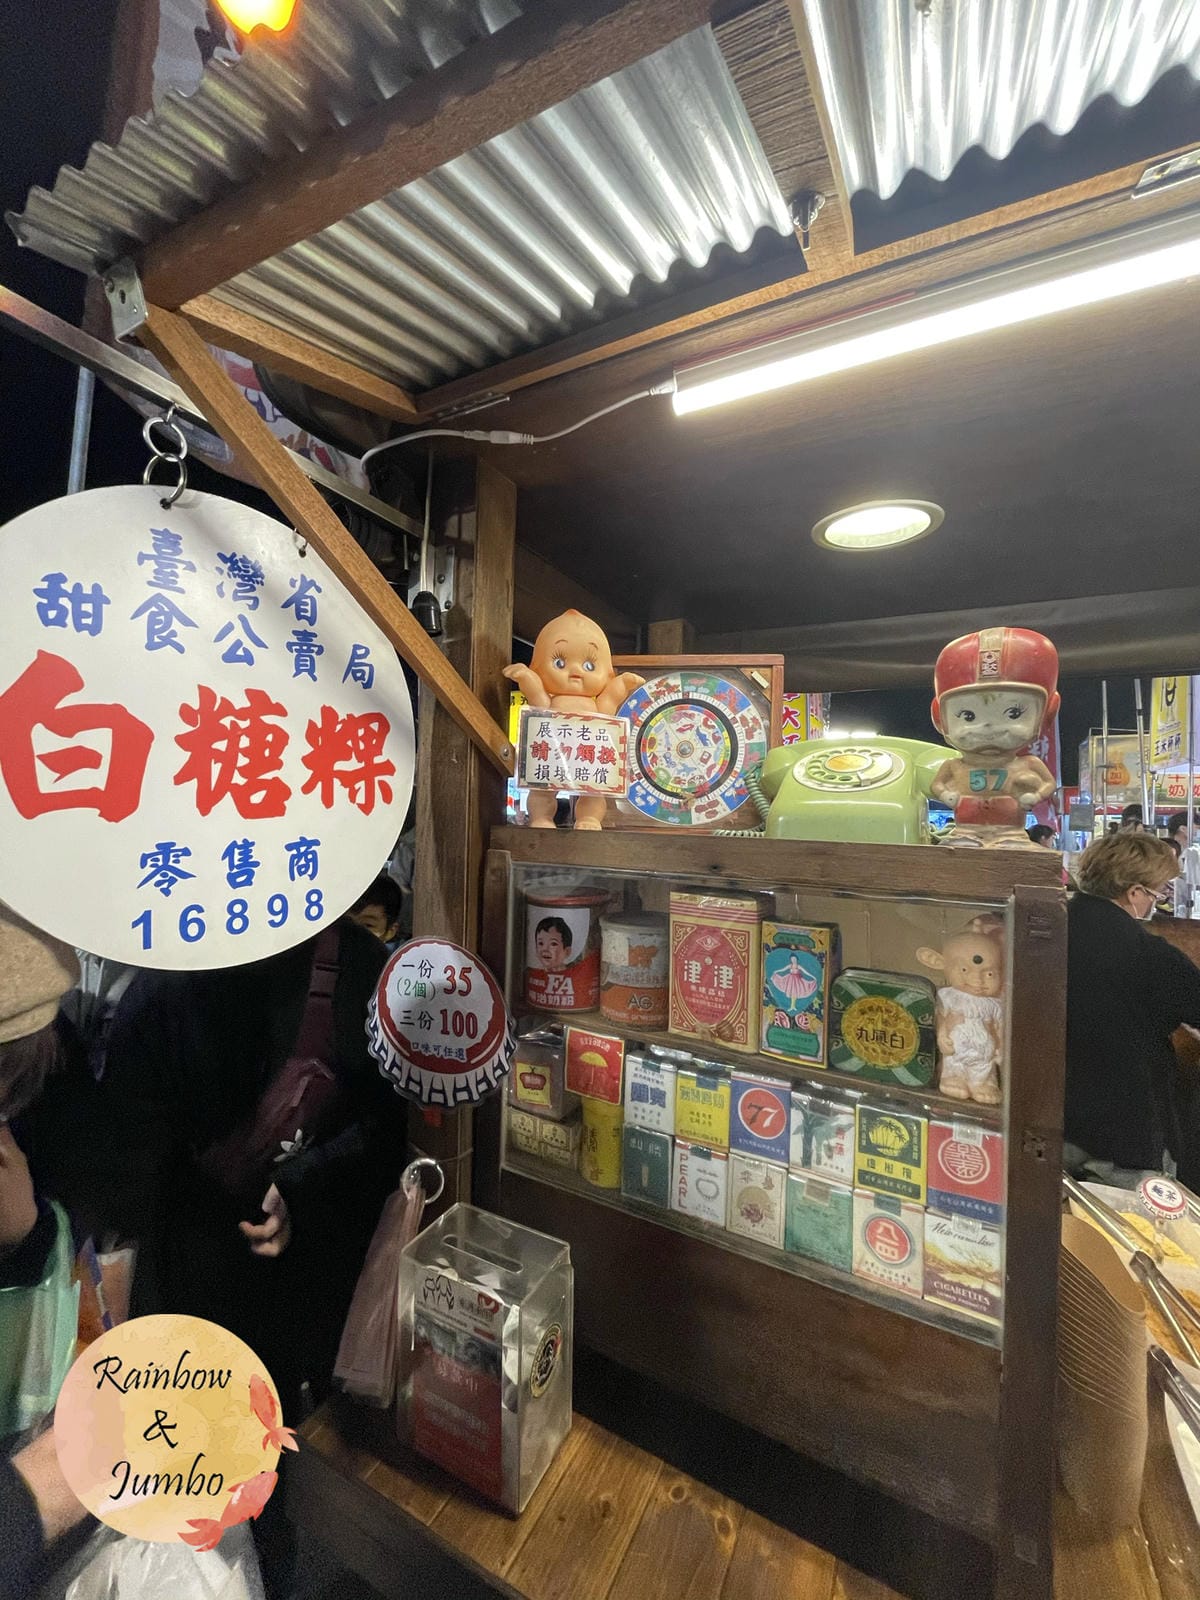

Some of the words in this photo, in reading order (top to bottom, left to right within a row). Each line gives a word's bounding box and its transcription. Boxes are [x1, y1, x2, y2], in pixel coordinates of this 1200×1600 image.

[136, 527, 323, 627] 臺灣省
[32, 571, 377, 691] 甜食公賣局
[0, 648, 398, 823] 白糖粿
[535, 720, 610, 743] 展示老品
[529, 739, 618, 767] 請勿觸摸
[533, 763, 610, 785] 損壞賠償
[968, 769, 1009, 793] 57
[136, 835, 323, 898] 零售商
[130, 888, 325, 951] 16898
[401, 958, 435, 979] 一份
[442, 964, 472, 997] 35
[545, 973, 575, 995] FA
[683, 959, 735, 990] 津津
[400, 1009, 435, 1031] 三份
[439, 1008, 479, 1040] 100
[677, 1152, 689, 1210] PEARL
